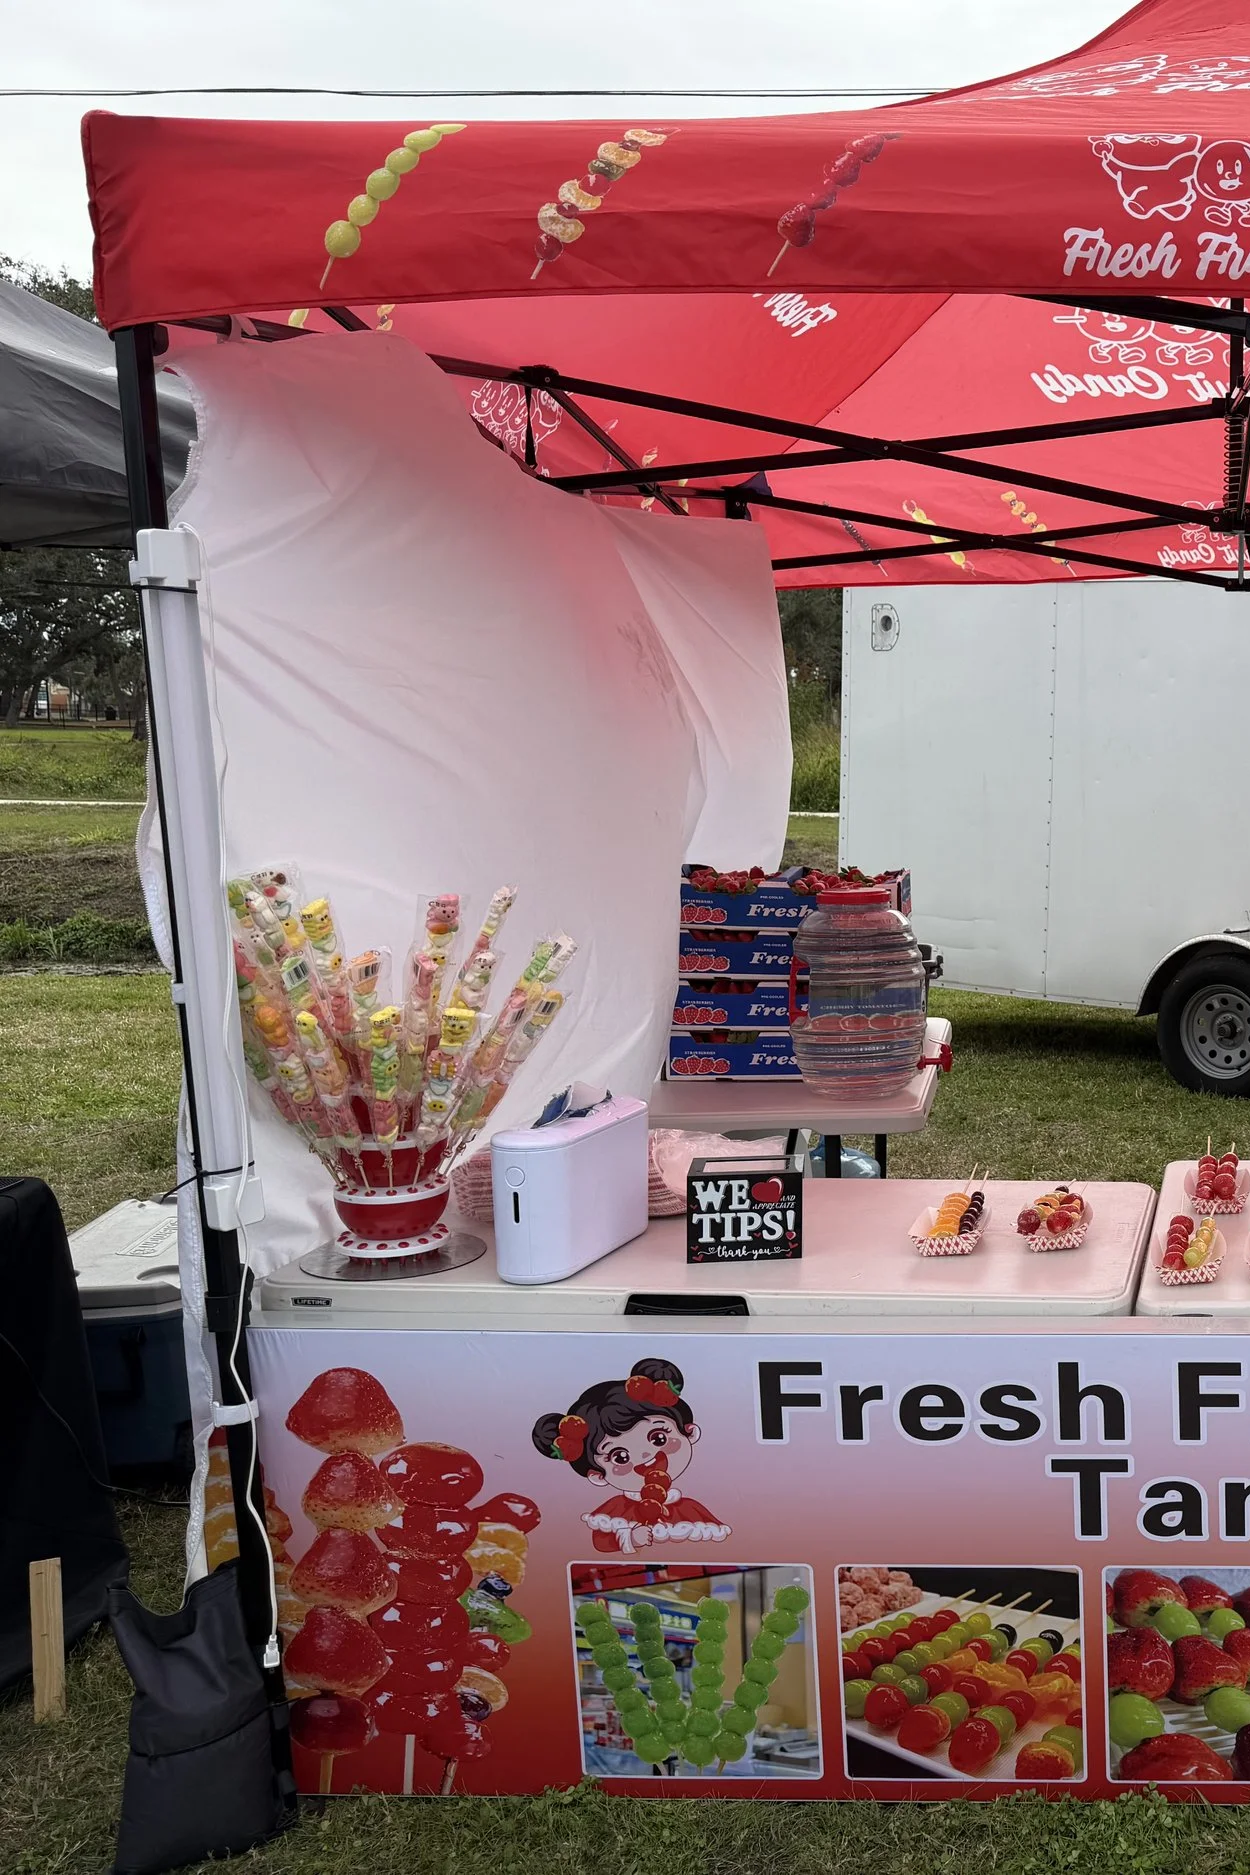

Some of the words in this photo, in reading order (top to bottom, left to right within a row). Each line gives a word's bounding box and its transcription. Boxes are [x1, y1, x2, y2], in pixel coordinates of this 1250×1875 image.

[1063, 227, 1182, 279] Fresh
[746, 904, 814, 918] Fresh
[749, 952, 793, 964] Fre
[749, 1053, 799, 1066] Fres
[692, 1179, 751, 1212] WE
[752, 1202, 796, 1210] APPRECIATE
[692, 1210, 797, 1243] TIPS!
[716, 1245, 750, 1258] thank
[752, 1247, 772, 1260] you
[757, 1360, 1127, 1442] Fresh
